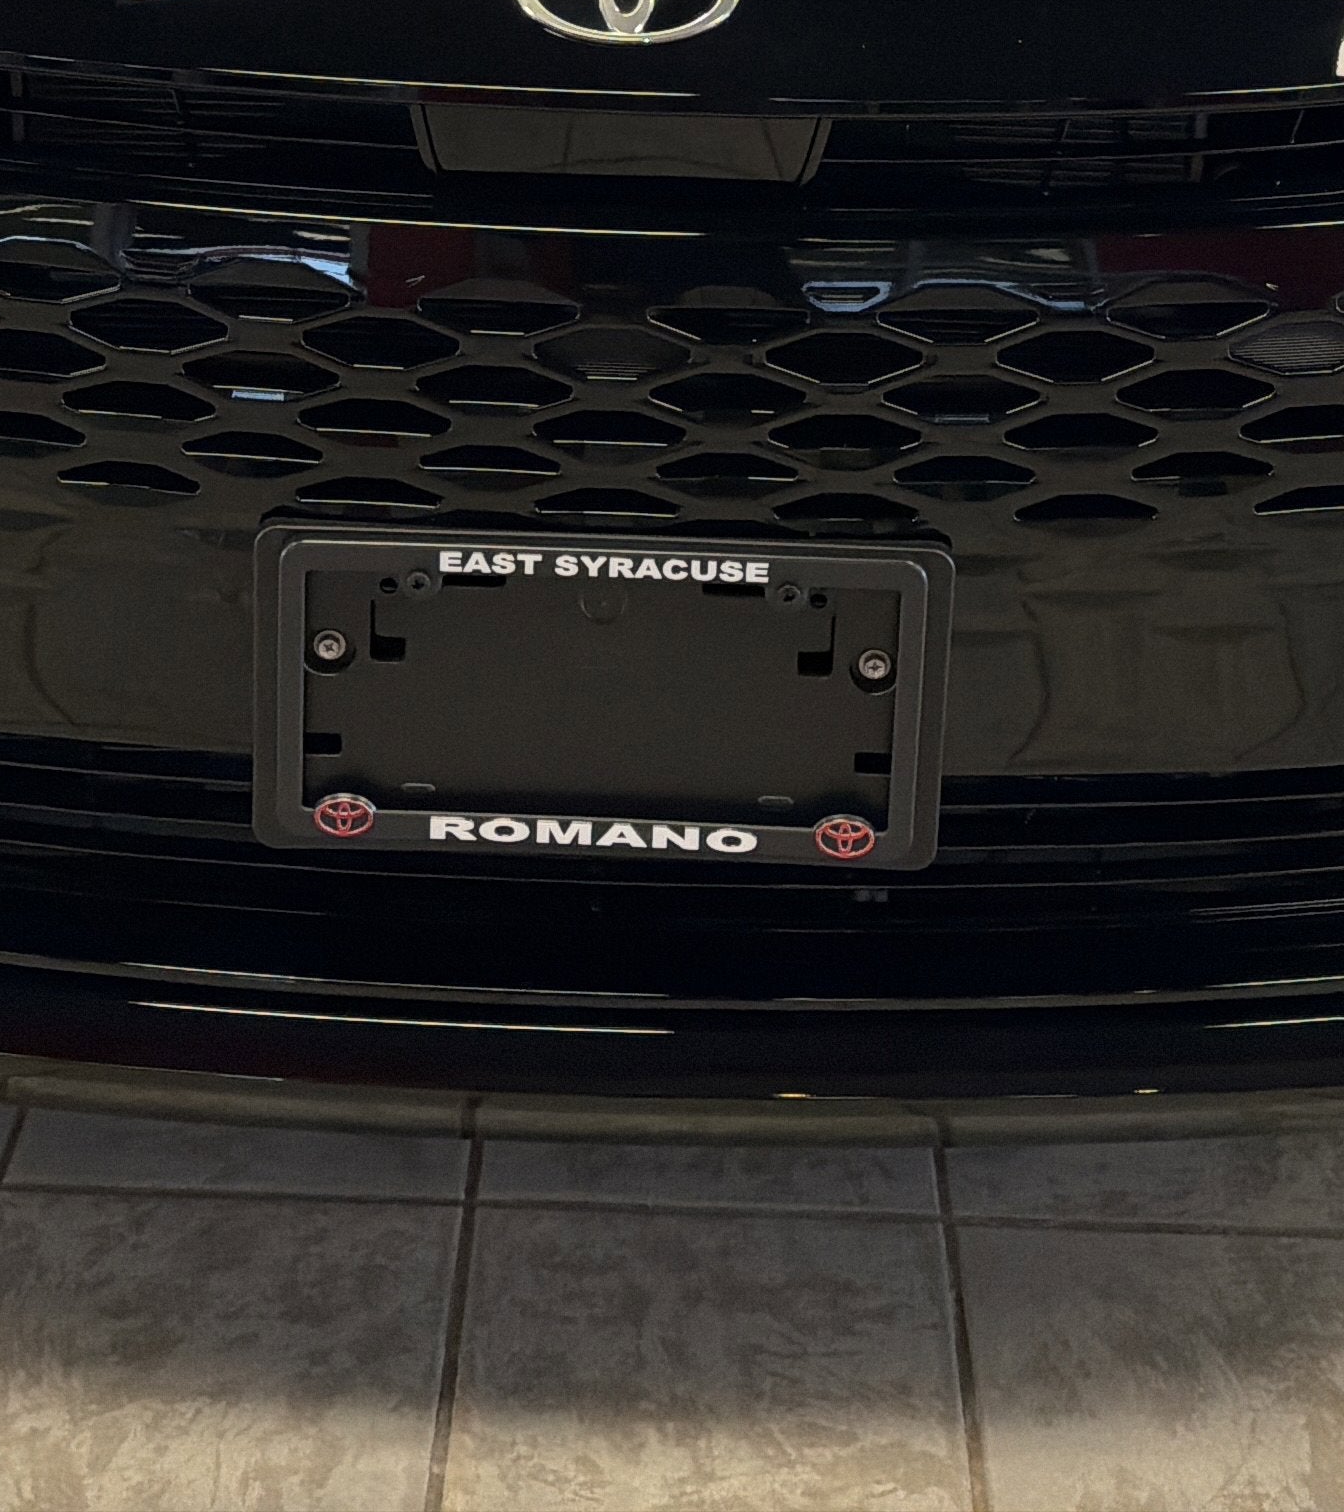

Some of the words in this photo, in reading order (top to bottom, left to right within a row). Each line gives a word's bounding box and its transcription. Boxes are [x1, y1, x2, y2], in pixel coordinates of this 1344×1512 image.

[438, 549, 543, 578] EAST
[554, 554, 771, 586] SYRACUSE
[428, 813, 760, 855] ROMANO
